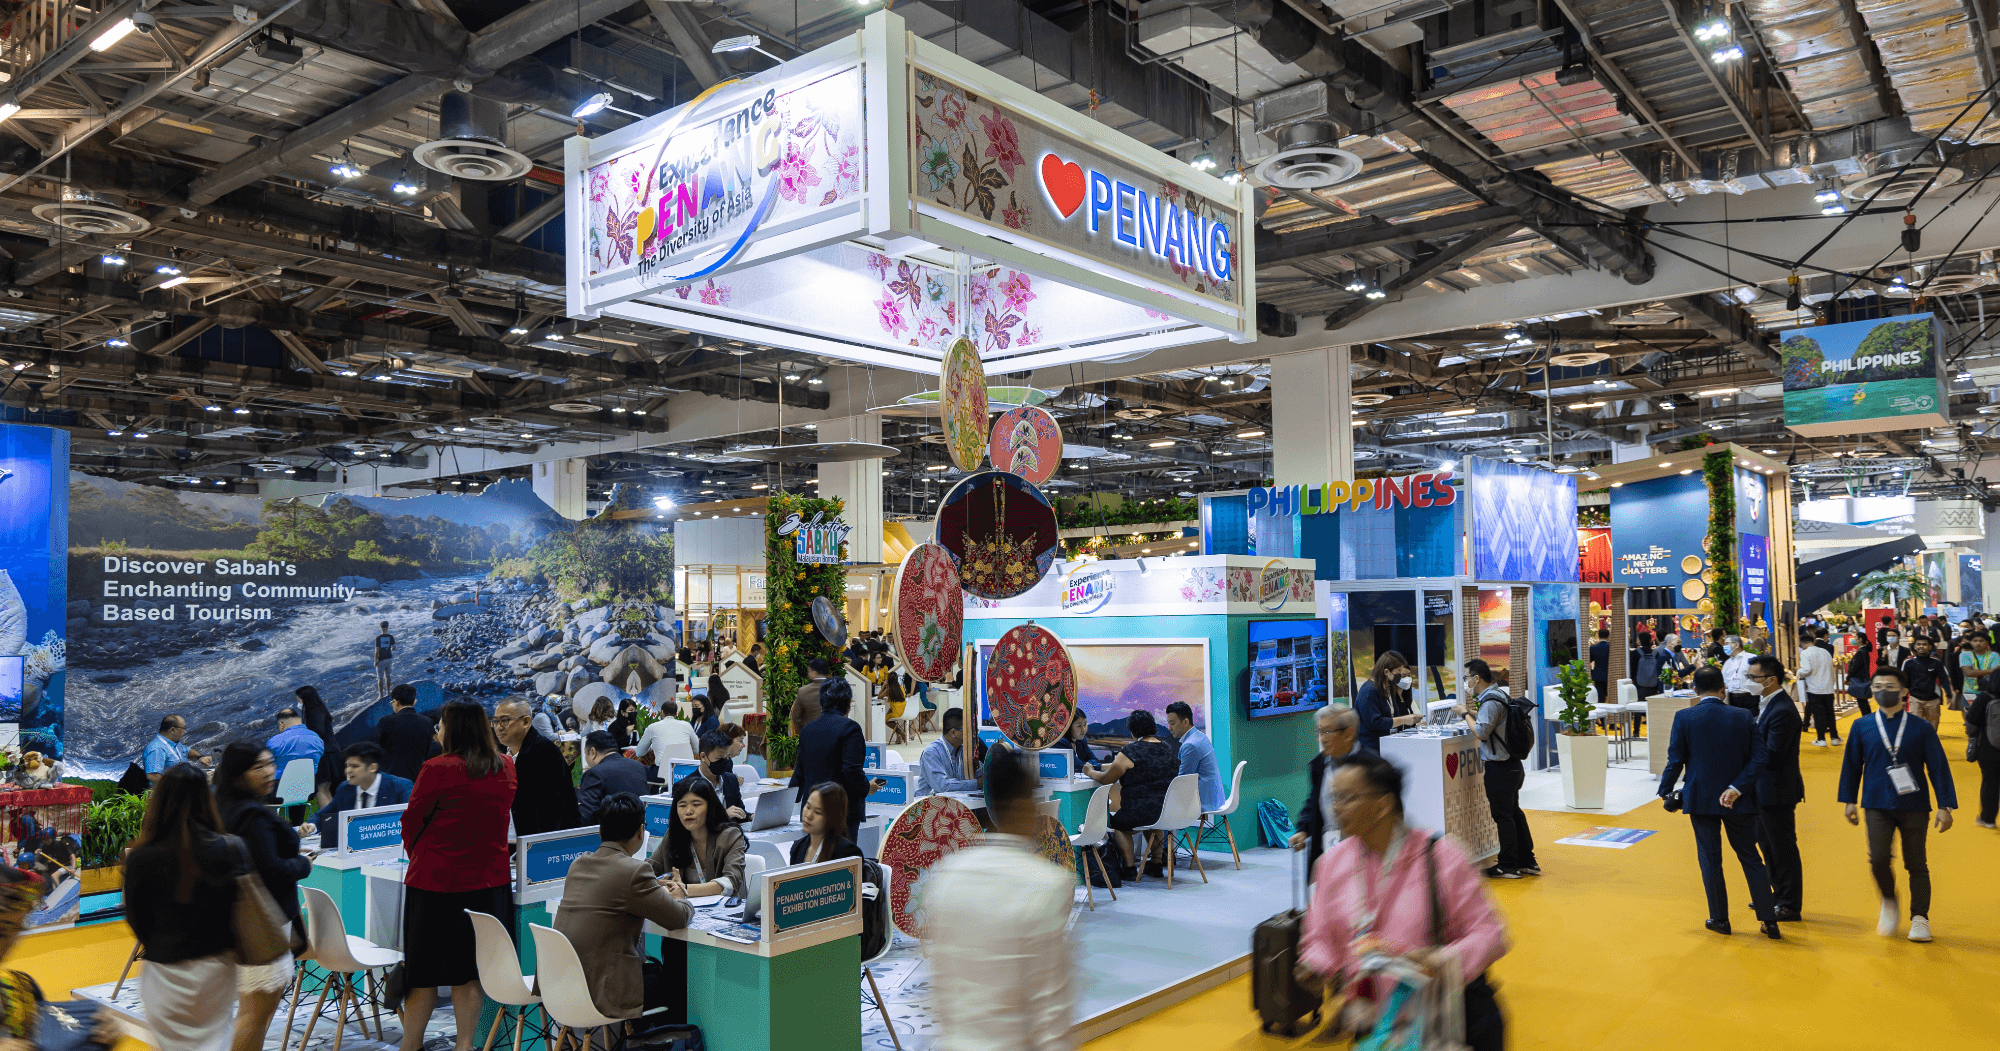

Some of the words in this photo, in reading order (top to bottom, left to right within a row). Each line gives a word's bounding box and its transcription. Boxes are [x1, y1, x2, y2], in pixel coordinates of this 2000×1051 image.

[636, 119, 782, 256] PENANG
[638, 254, 657, 276] The
[659, 216, 709, 261] Diversity
[712, 199, 726, 223] of
[727, 186, 752, 214] Asia
[1088, 169, 1231, 281] PENANG
[1820, 350, 1921, 374] PHILIPPINES
[1247, 472, 1456, 519] PHILIPPINES
[778, 511, 853, 543] Enchanting
[797, 529, 838, 556] SABAH
[104, 557, 206, 574] Discover
[215, 559, 297, 576] Sabah's
[1620, 566, 1668, 575] CHAPTERS
[104, 581, 232, 602] Enchanting
[242, 582, 363, 602] Community-
[103, 605, 175, 621] Based
[186, 605, 271, 620] Tourism
[359, 822, 396, 833] SHANGRI-LA
[361, 831, 387, 840] SAYANG
[548, 856, 560, 864] PTS
[776, 891, 804, 906] PENANG
[805, 881, 846, 900] CONVENTION
[847, 880, 852, 889] &
[782, 898, 819, 916] EXHIBITION
[820, 892, 846, 906] BUREAU
